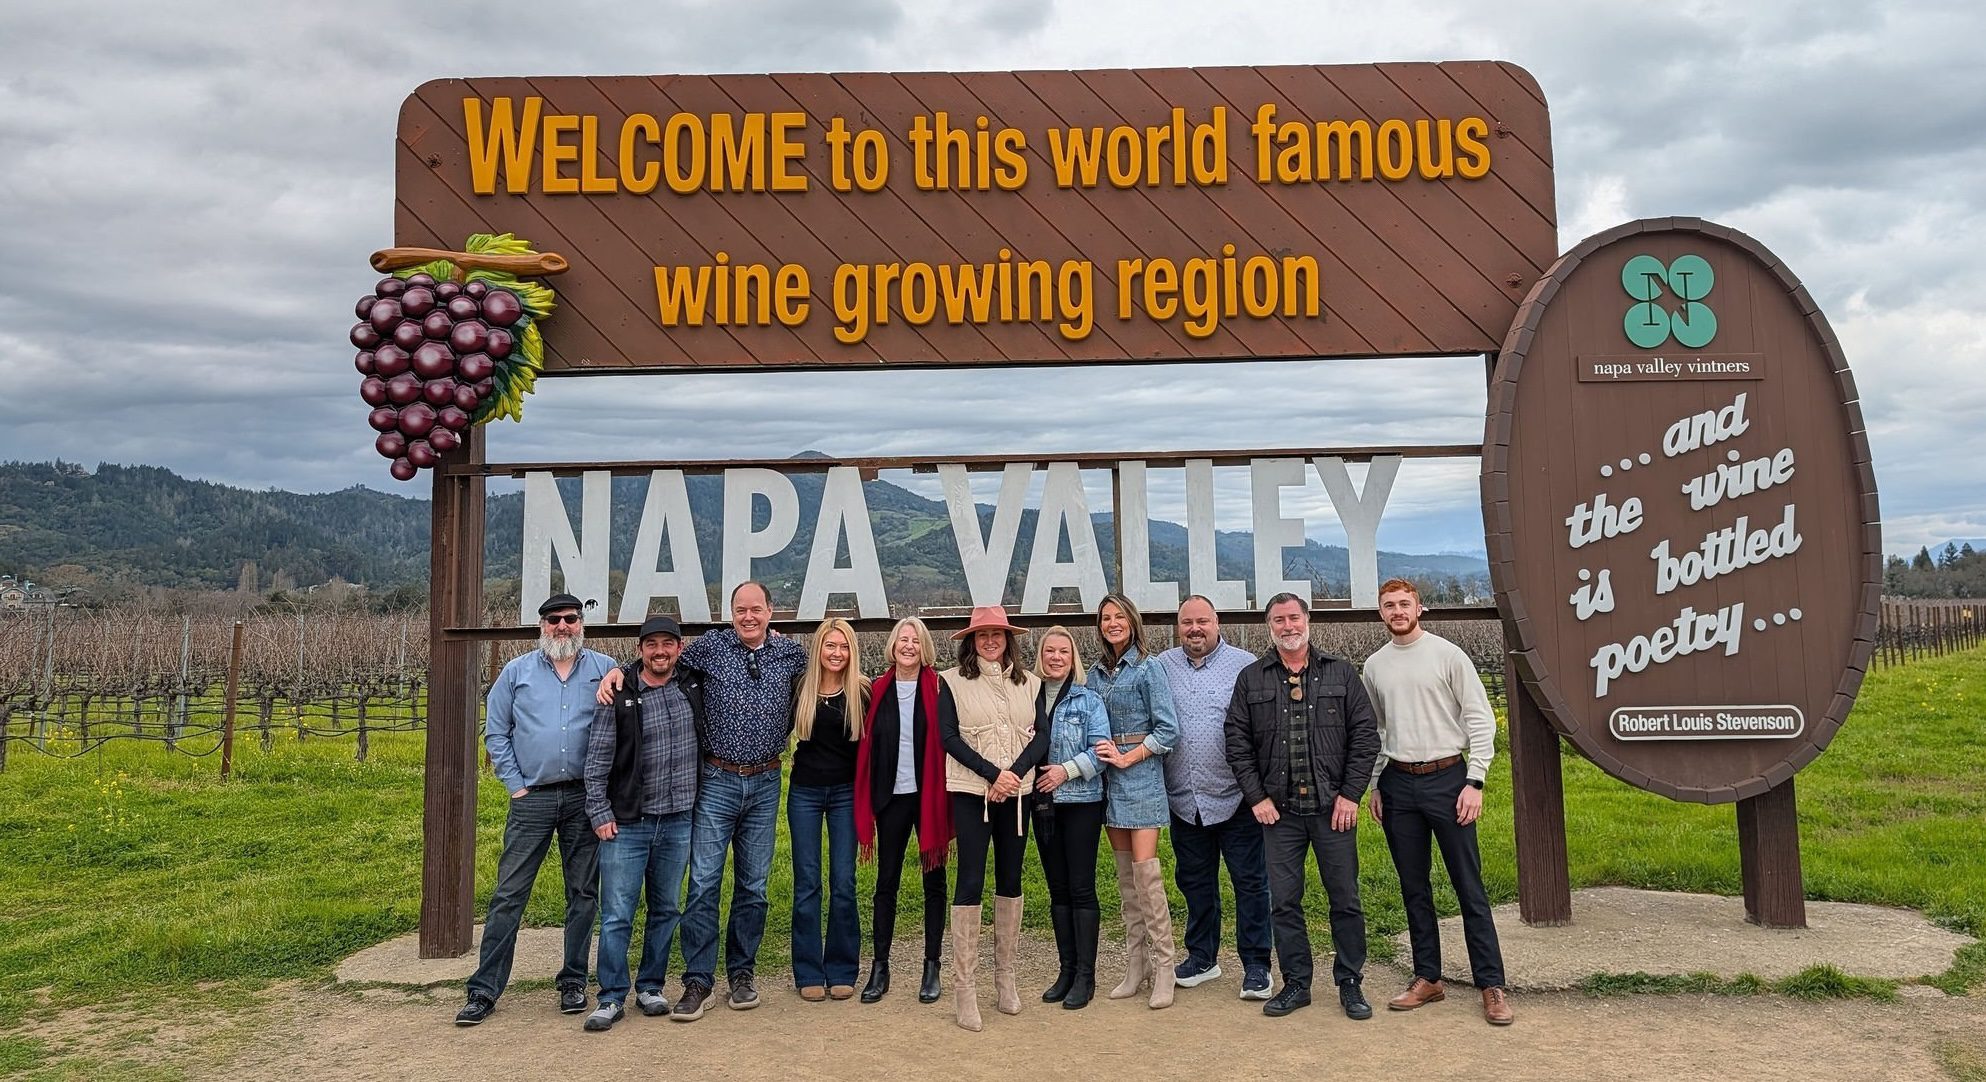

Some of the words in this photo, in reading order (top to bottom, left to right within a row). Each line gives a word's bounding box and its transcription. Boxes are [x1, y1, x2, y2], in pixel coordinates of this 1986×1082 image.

[463, 96, 808, 195] WELCOME
[826, 116, 889, 192] to
[908, 111, 1029, 191] this
[1047, 105, 1229, 189] world
[1251, 103, 1491, 184] famous
[654, 252, 811, 327] wine
[833, 249, 1093, 344] growing
[1118, 244, 1320, 338] region
[1593, 362, 1633, 379] napa
[1635, 357, 1684, 377] valley
[1686, 357, 1750, 374] vintners
[520, 466, 890, 626] NAPA
[936, 454, 1403, 615] VALLEY
[1565, 492, 1644, 549] the
[1682, 447, 1795, 512] wine
[1569, 568, 1616, 621] is
[1650, 503, 1803, 595] bottled
[1618, 713, 1670, 732] Robert
[1672, 712, 1714, 732] Louis
[1716, 711, 1796, 731] Stevenson
